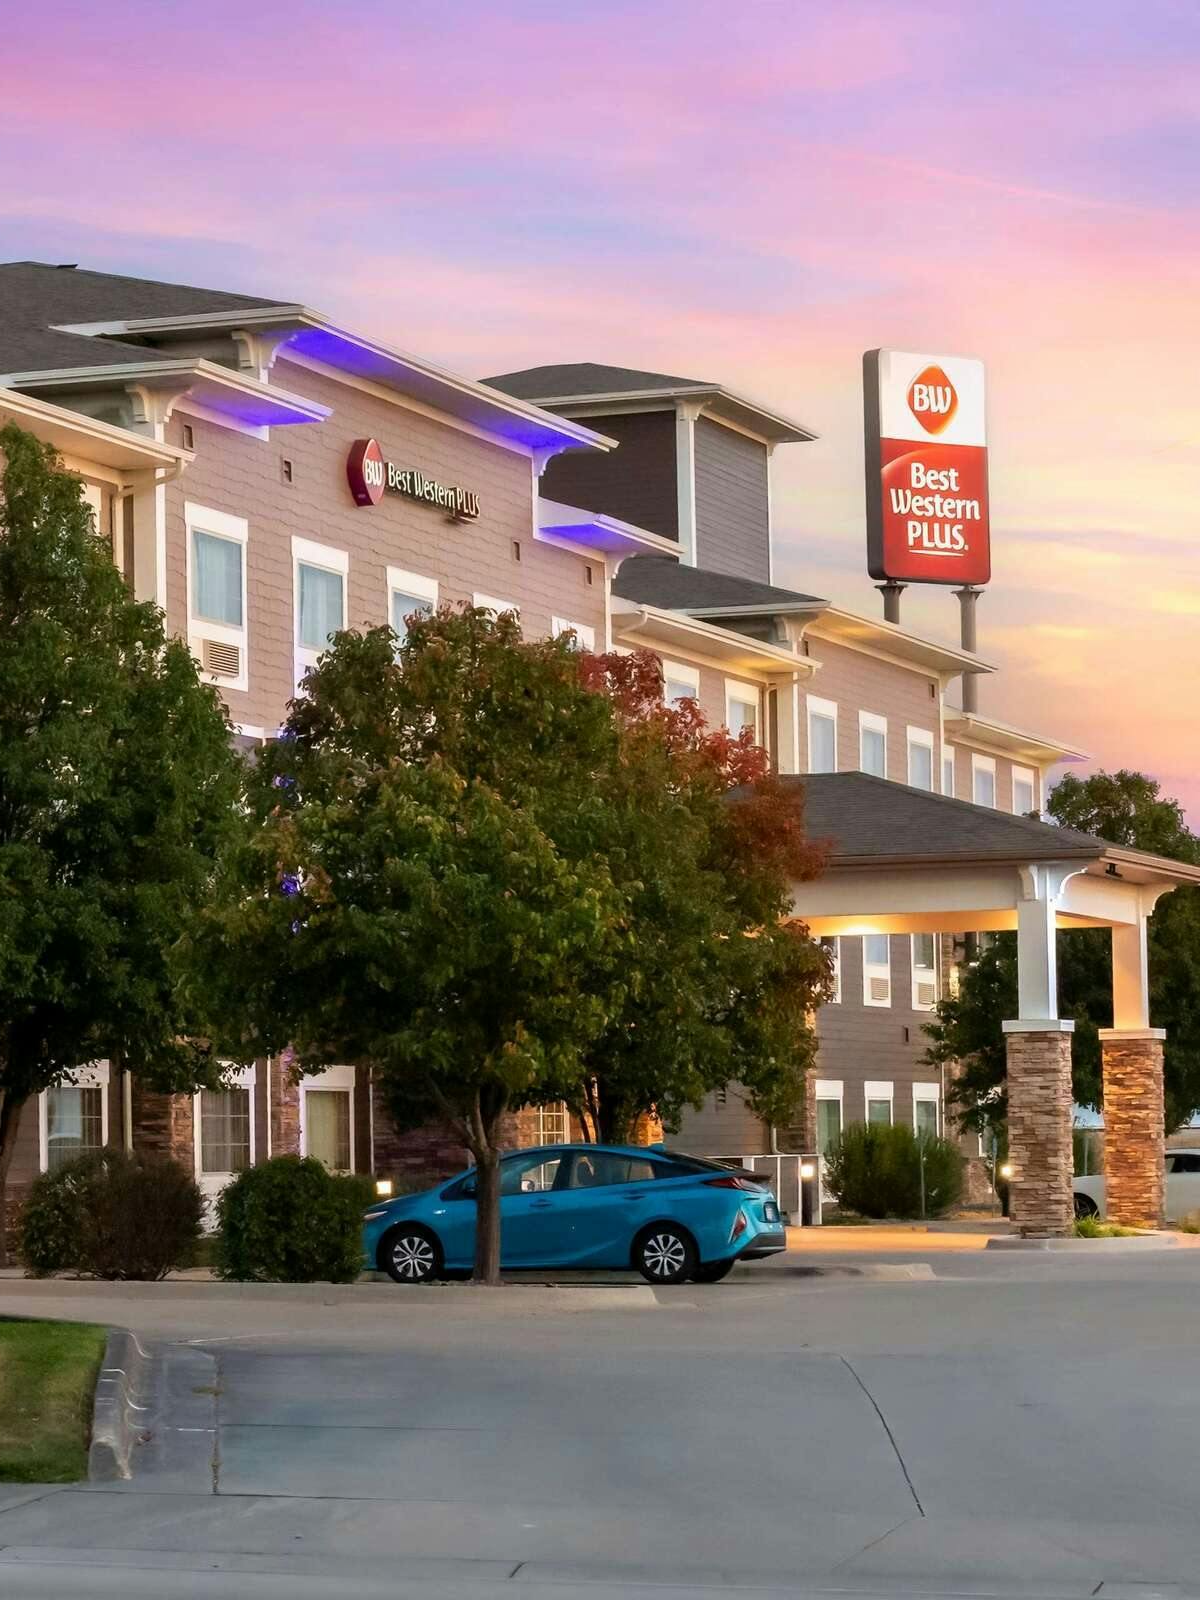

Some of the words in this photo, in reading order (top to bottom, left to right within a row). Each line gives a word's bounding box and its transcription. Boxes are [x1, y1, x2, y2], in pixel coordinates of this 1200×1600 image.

[913, 384, 951, 414] BW
[364, 459, 383, 486] BW
[910, 462, 960, 492] Best
[388, 462, 412, 494] Best
[413, 471, 456, 509] Western
[456, 487, 481, 517] PLUS
[890, 488, 981, 520] Western
